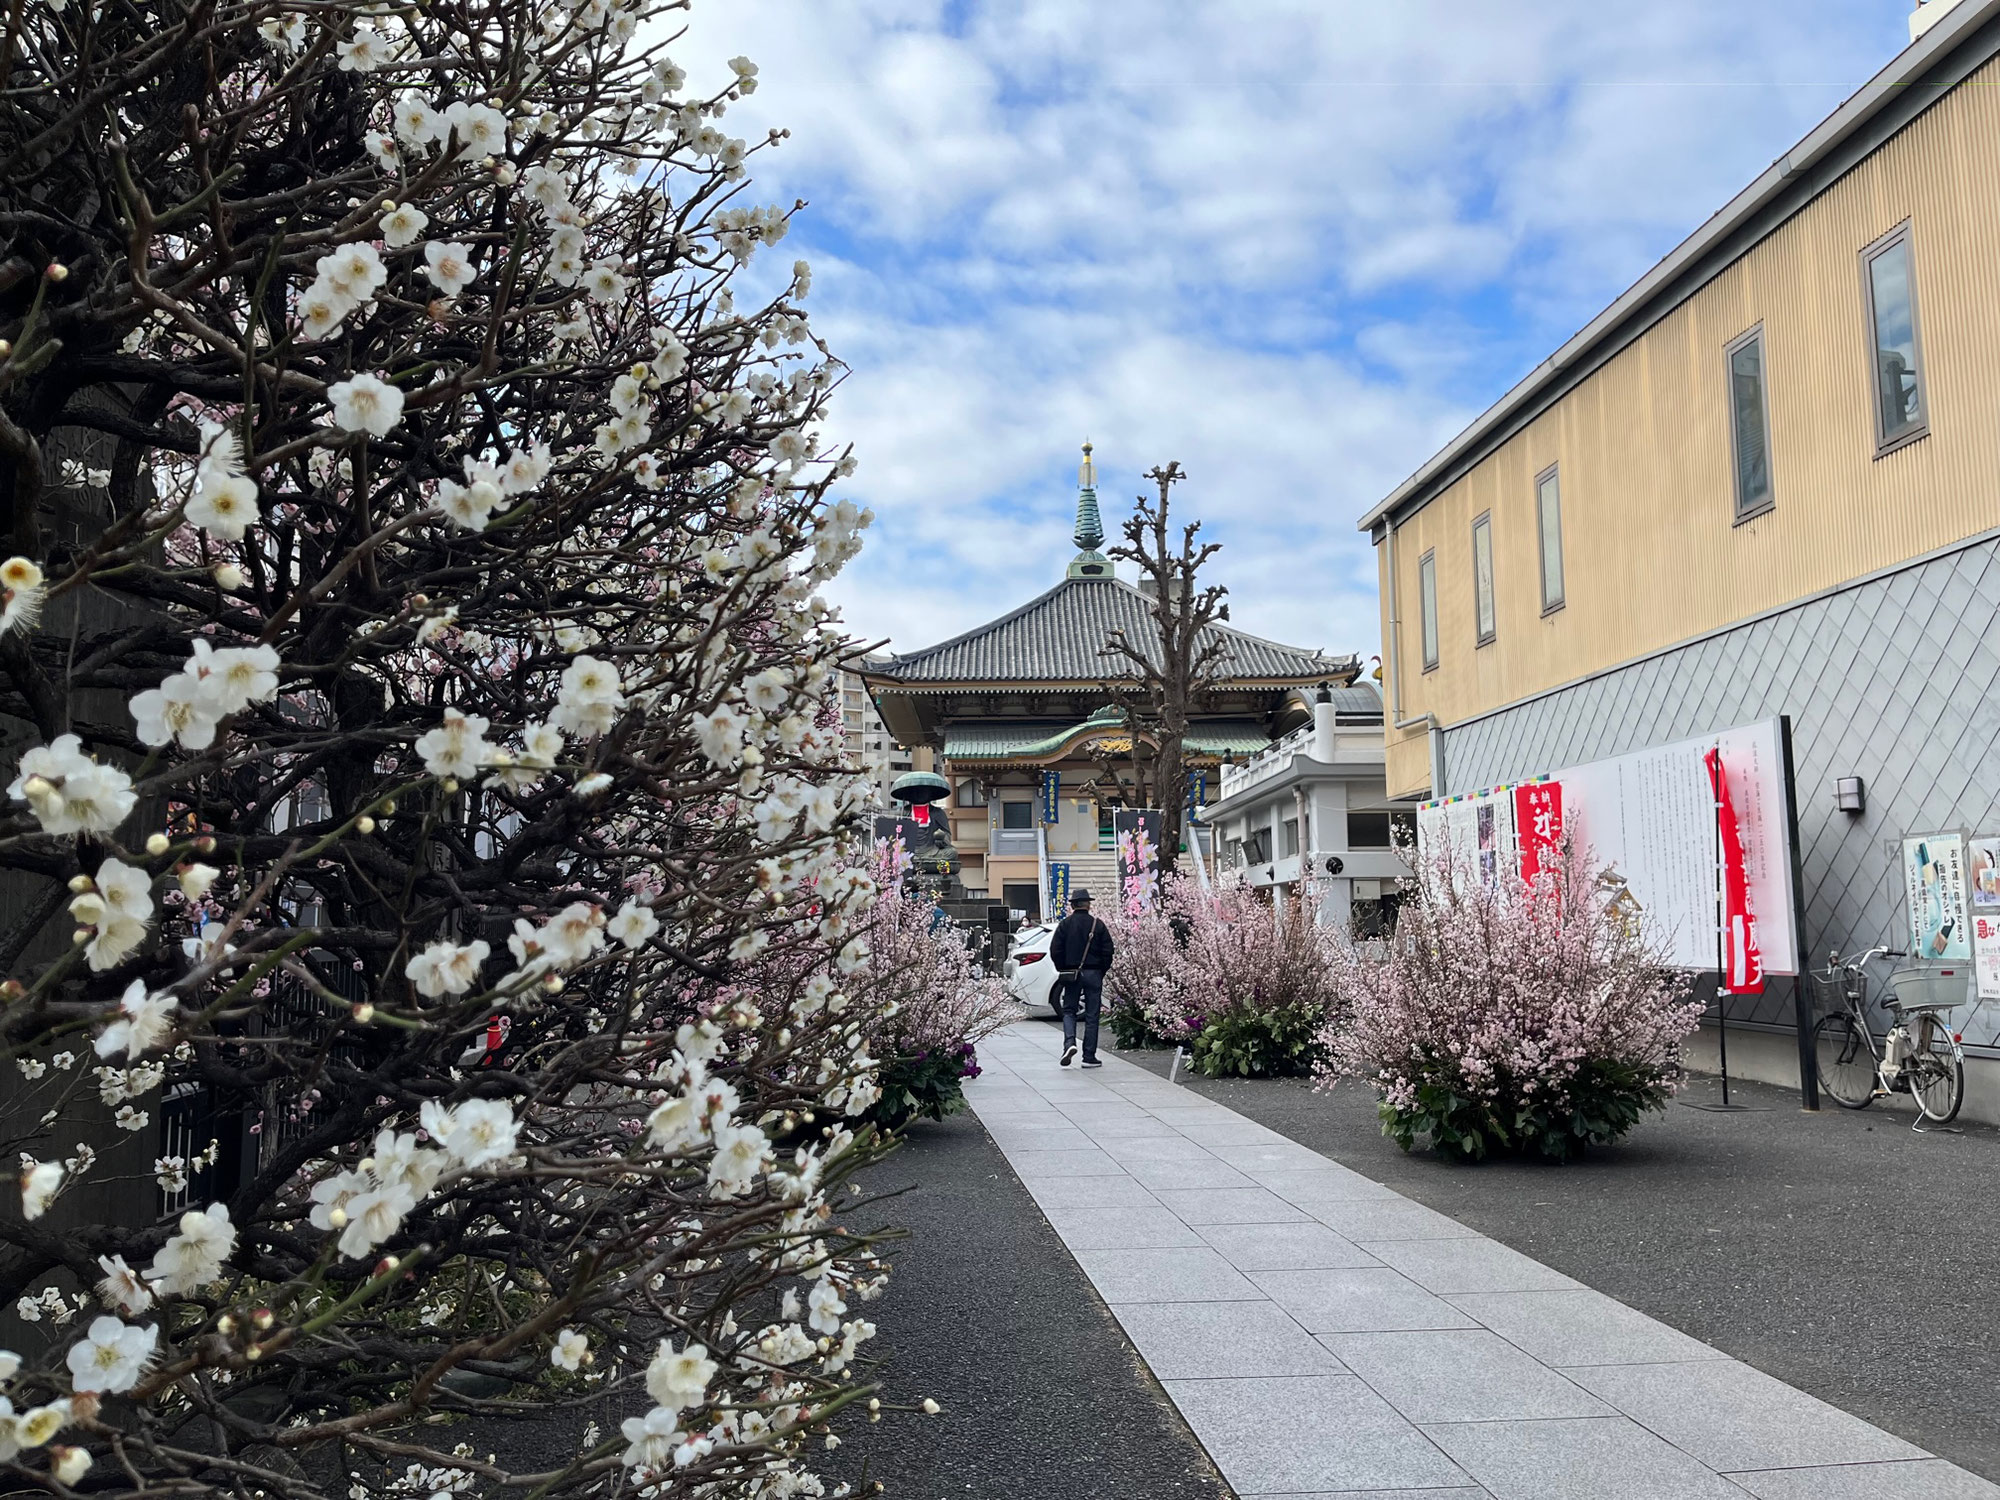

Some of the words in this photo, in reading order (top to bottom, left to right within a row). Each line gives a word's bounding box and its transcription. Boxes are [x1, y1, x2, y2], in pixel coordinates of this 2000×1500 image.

[1528, 790, 1551, 805] 奉納
[1909, 864, 1921, 948] ジェルネイルやってます
[1938, 864, 1950, 924] 指先のオシャレ
[1949, 849, 1964, 943] お友達に自慢できる
